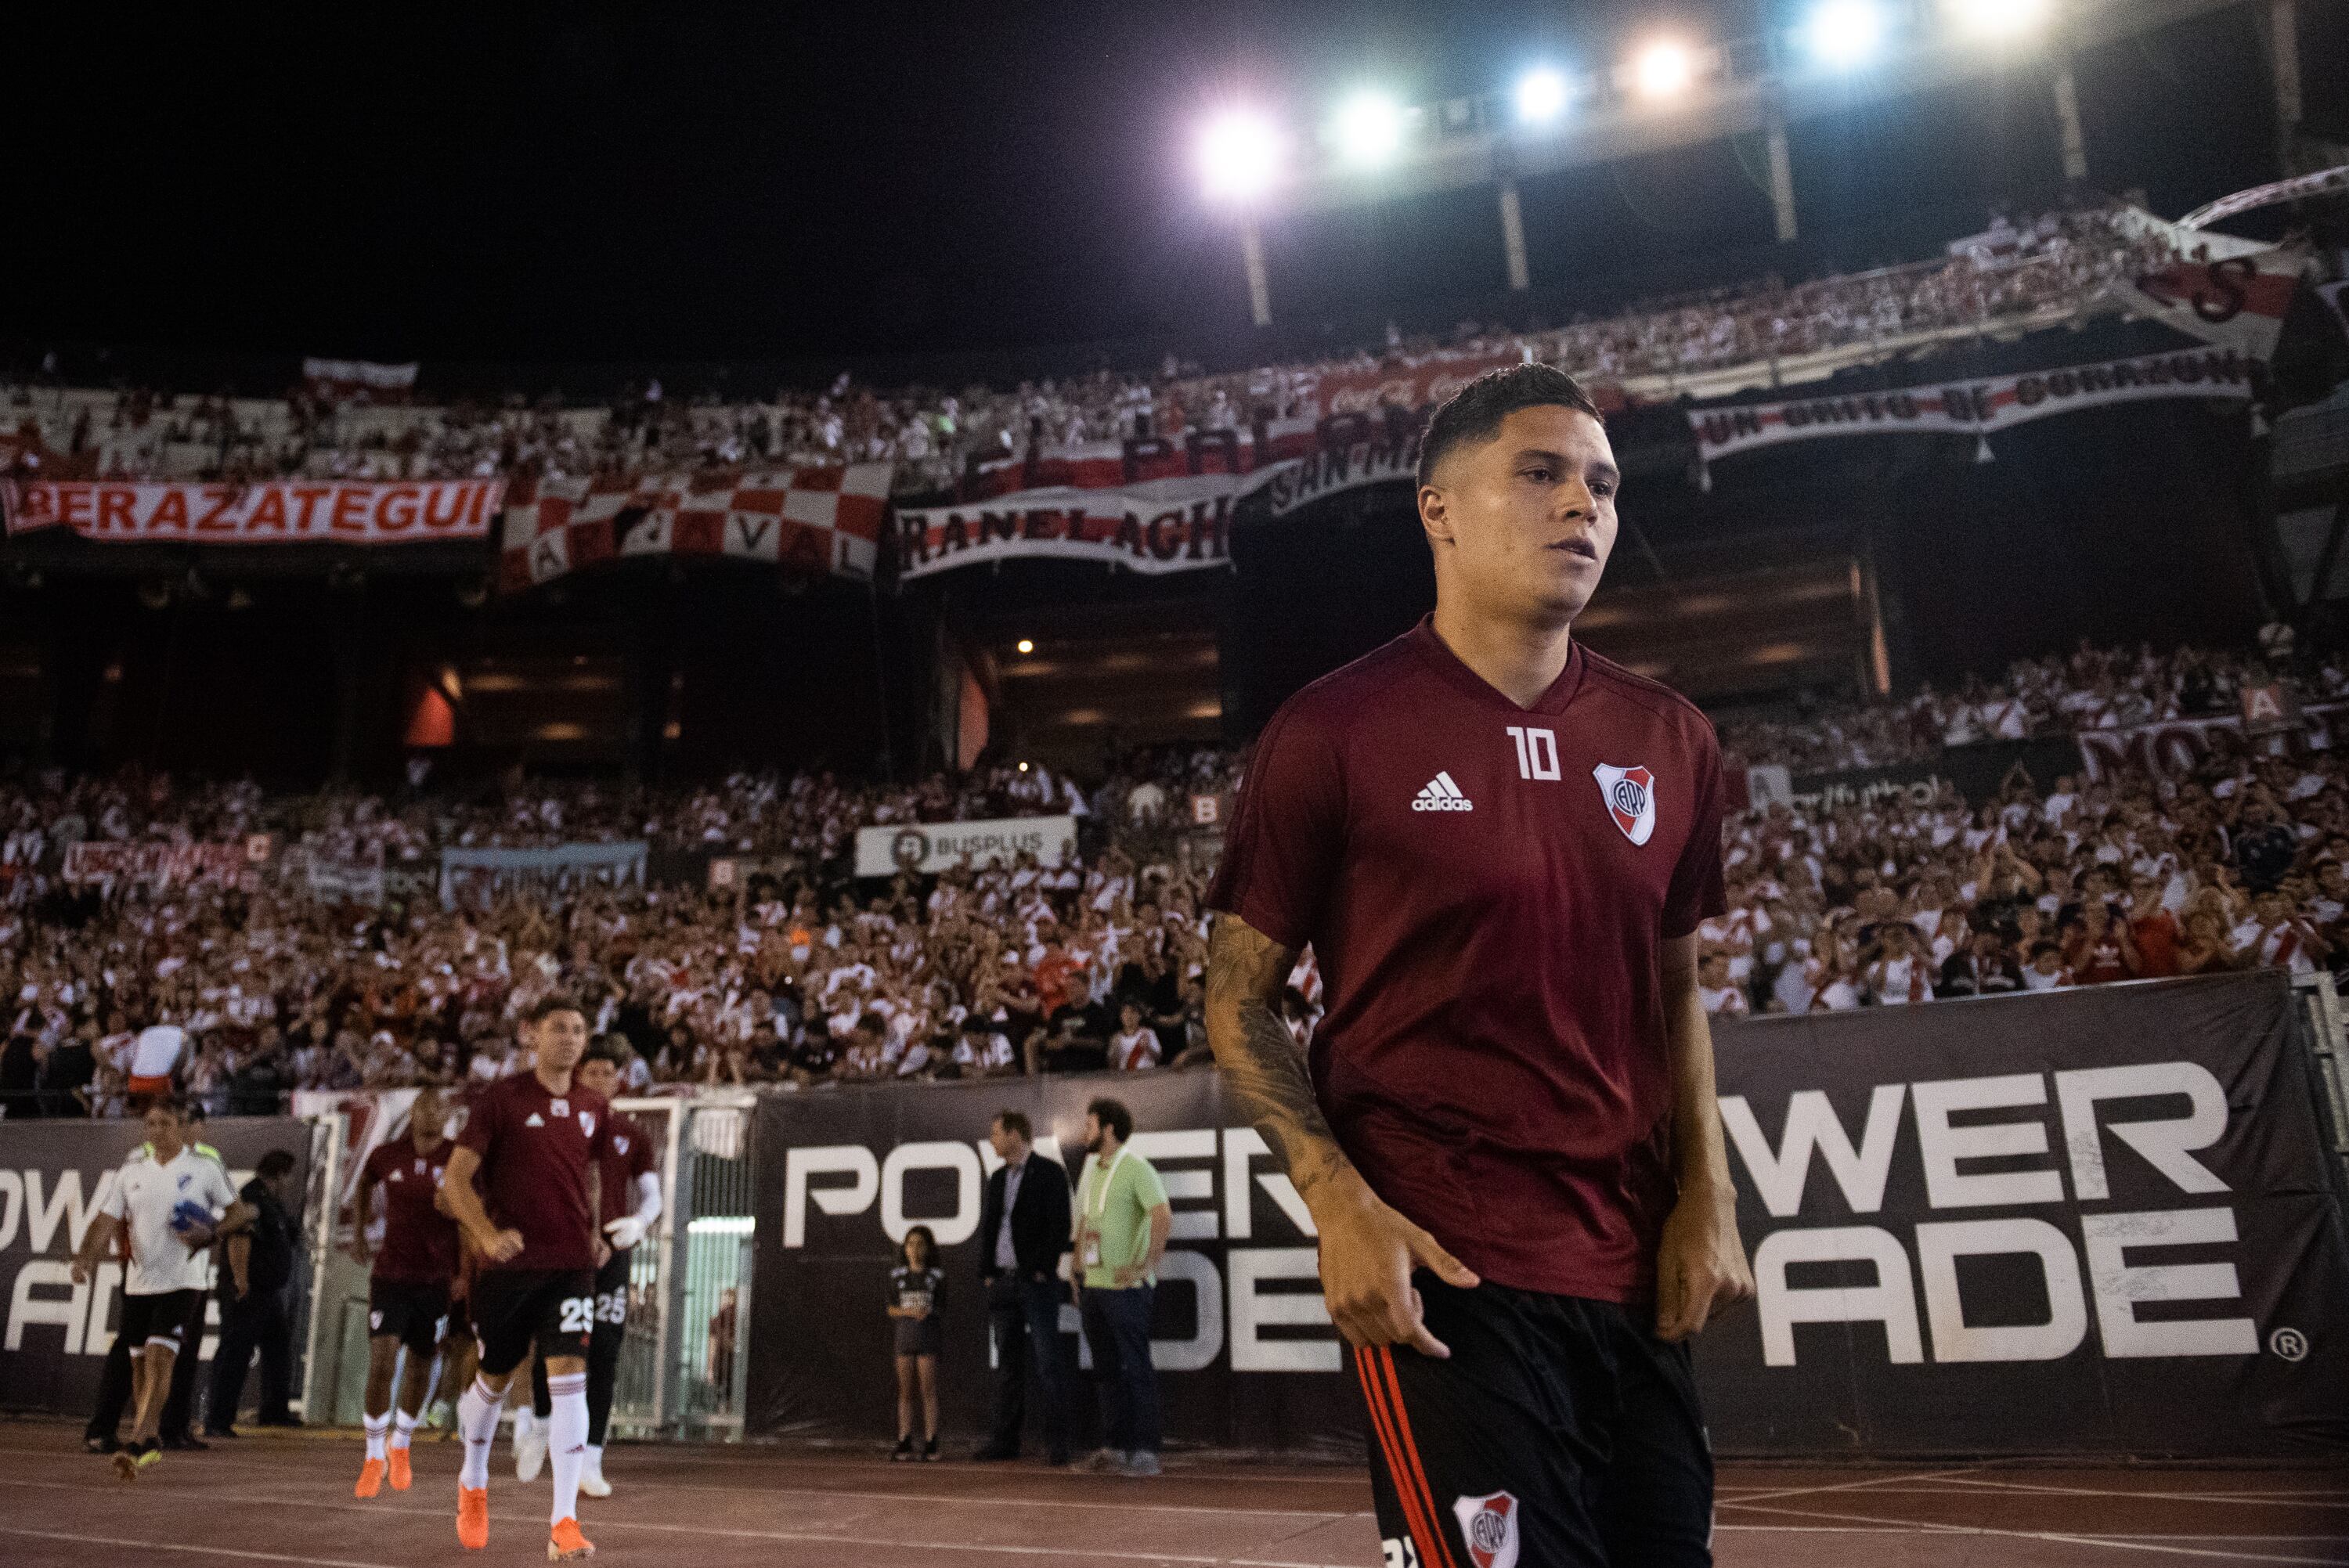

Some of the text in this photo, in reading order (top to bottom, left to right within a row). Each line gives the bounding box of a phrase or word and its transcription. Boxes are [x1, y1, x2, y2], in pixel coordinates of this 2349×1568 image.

[23, 485, 487, 532] BERAZATEGUI
[900, 496, 1229, 570] RANELAGH
[2251, 689, 2282, 719] A
[1506, 726, 1561, 780] 10
[1196, 797, 1218, 823] B
[1412, 796, 1473, 812] adidas
[935, 833, 1043, 856] BUSPLUS
[1717, 1061, 2233, 1218] WER
[1754, 1206, 2261, 1368] ADE
[596, 1292, 626, 1325] 25
